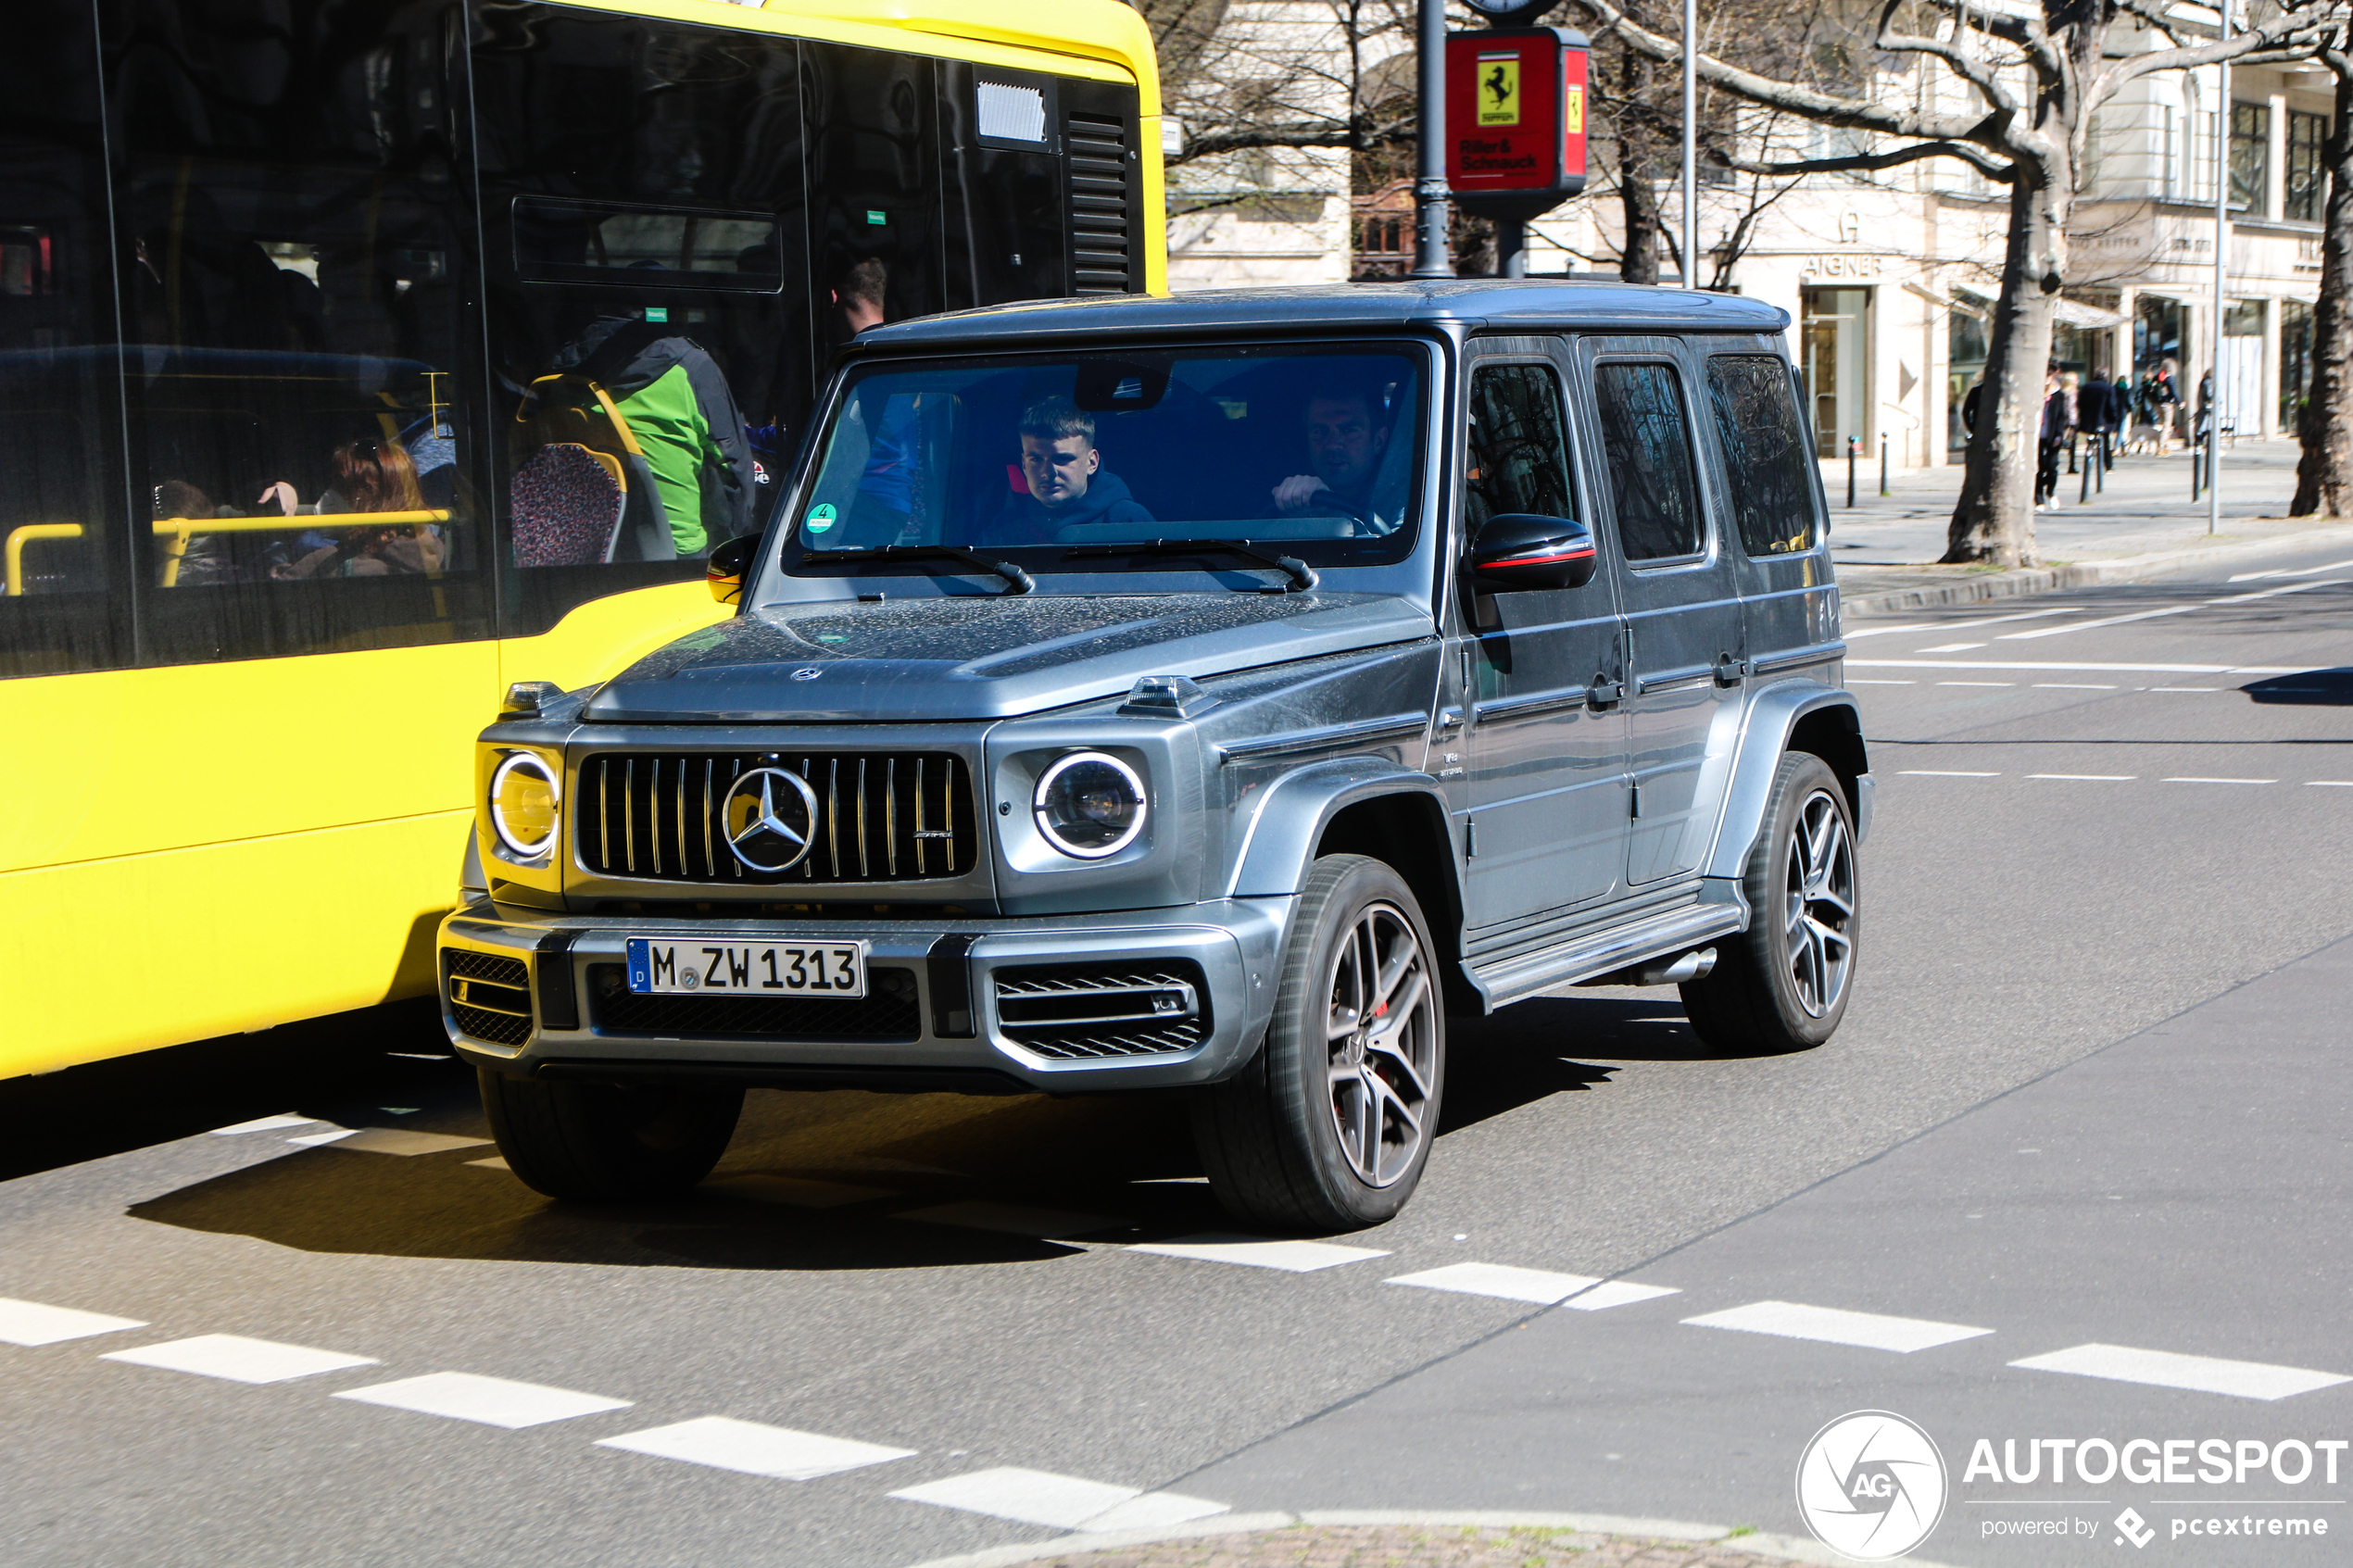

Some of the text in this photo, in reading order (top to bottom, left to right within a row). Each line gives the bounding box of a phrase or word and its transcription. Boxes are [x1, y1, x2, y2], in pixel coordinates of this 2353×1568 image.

[1499, 138, 1511, 153] &
[1460, 154, 1537, 170] Schnauck
[1799, 255, 1882, 277] AIGNER
[818, 504, 828, 519] 4
[651, 947, 855, 990] M ZW 1313
[635, 971, 645, 983] D
